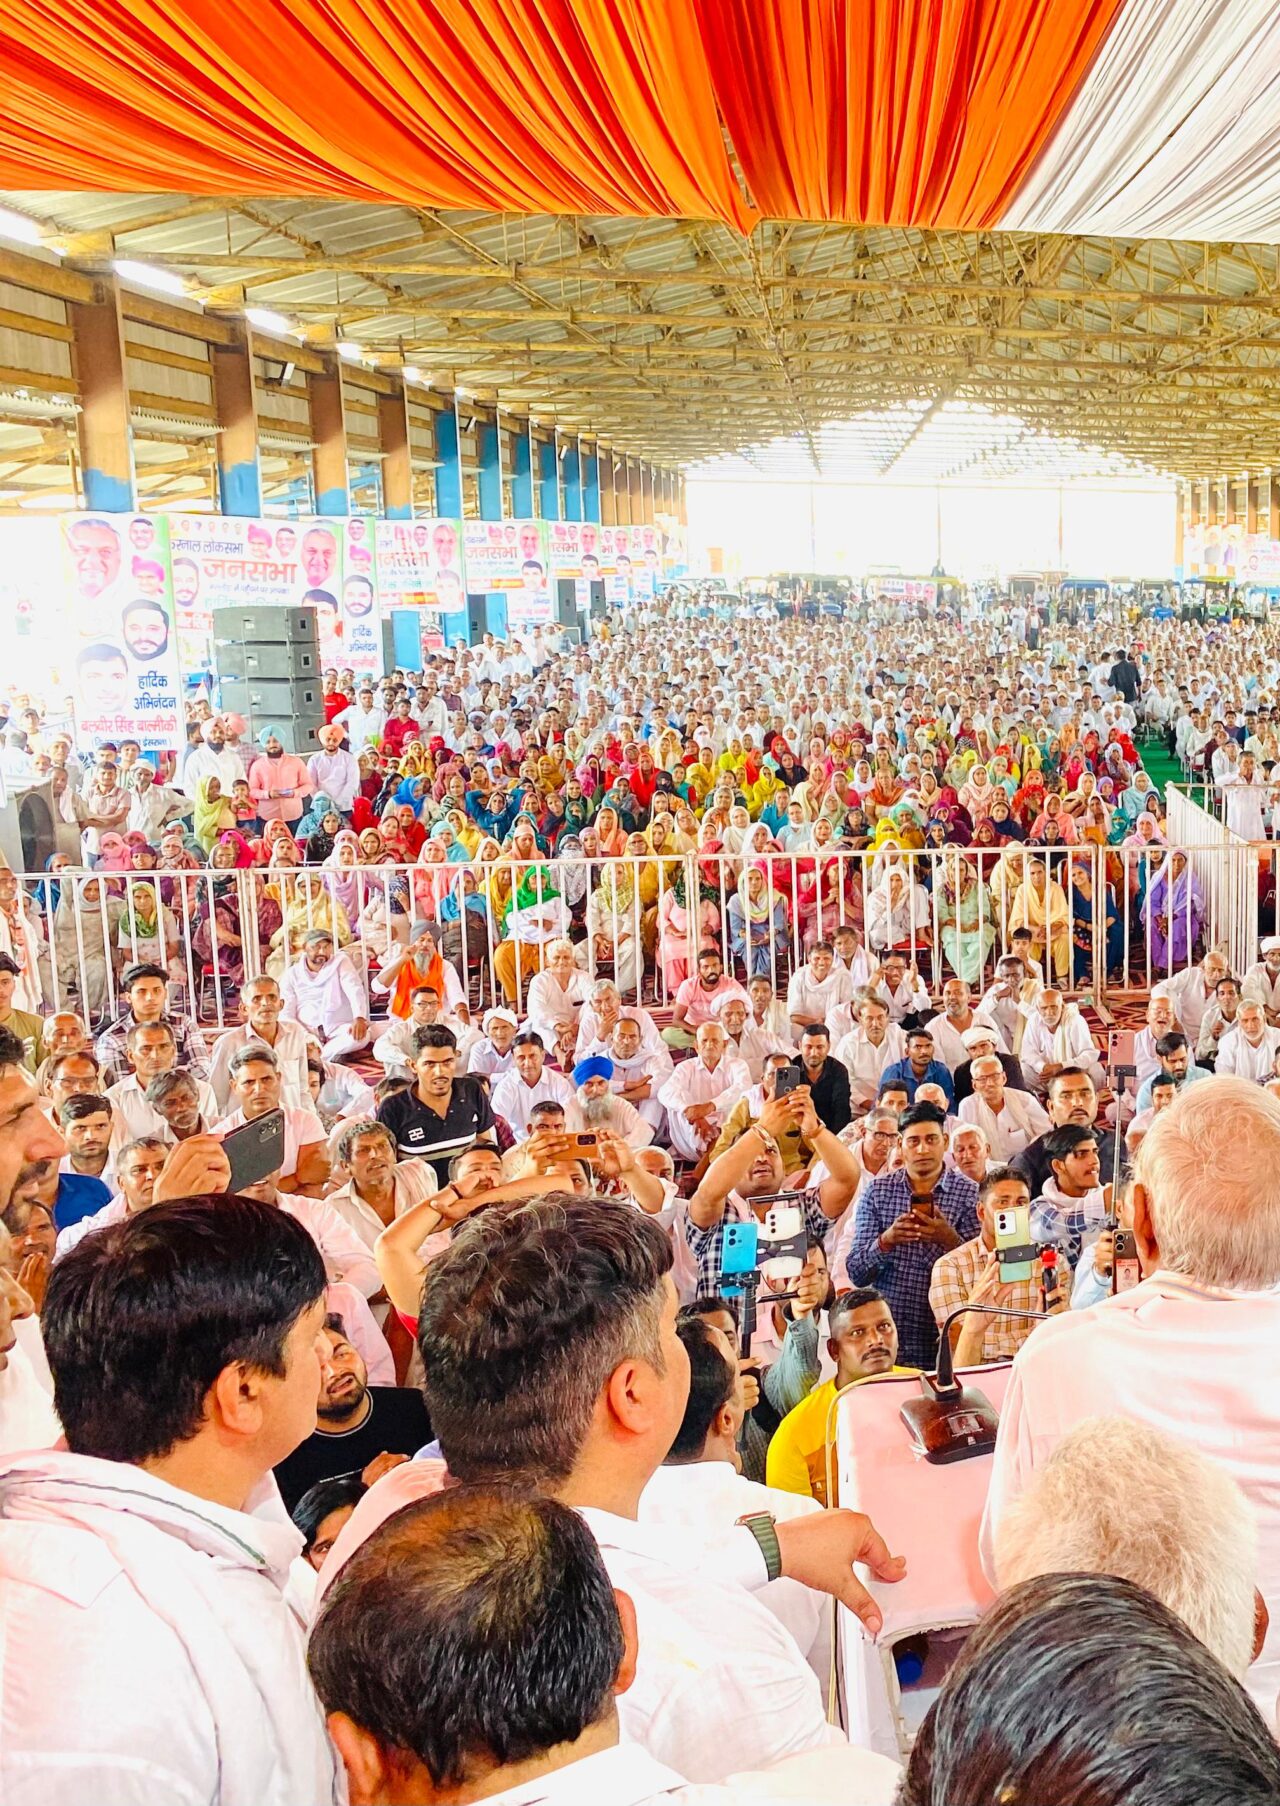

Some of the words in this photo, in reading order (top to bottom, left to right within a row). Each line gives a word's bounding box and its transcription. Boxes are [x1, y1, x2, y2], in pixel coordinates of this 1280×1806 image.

[203, 537, 244, 555] लोकसभा
[465, 547, 517, 559] जनसभा
[201, 558, 297, 585] जनसभा
[137, 670, 168, 690] हार्दिक
[134, 692, 176, 710] अभिनंदन
[115, 714, 134, 734] सिंह
